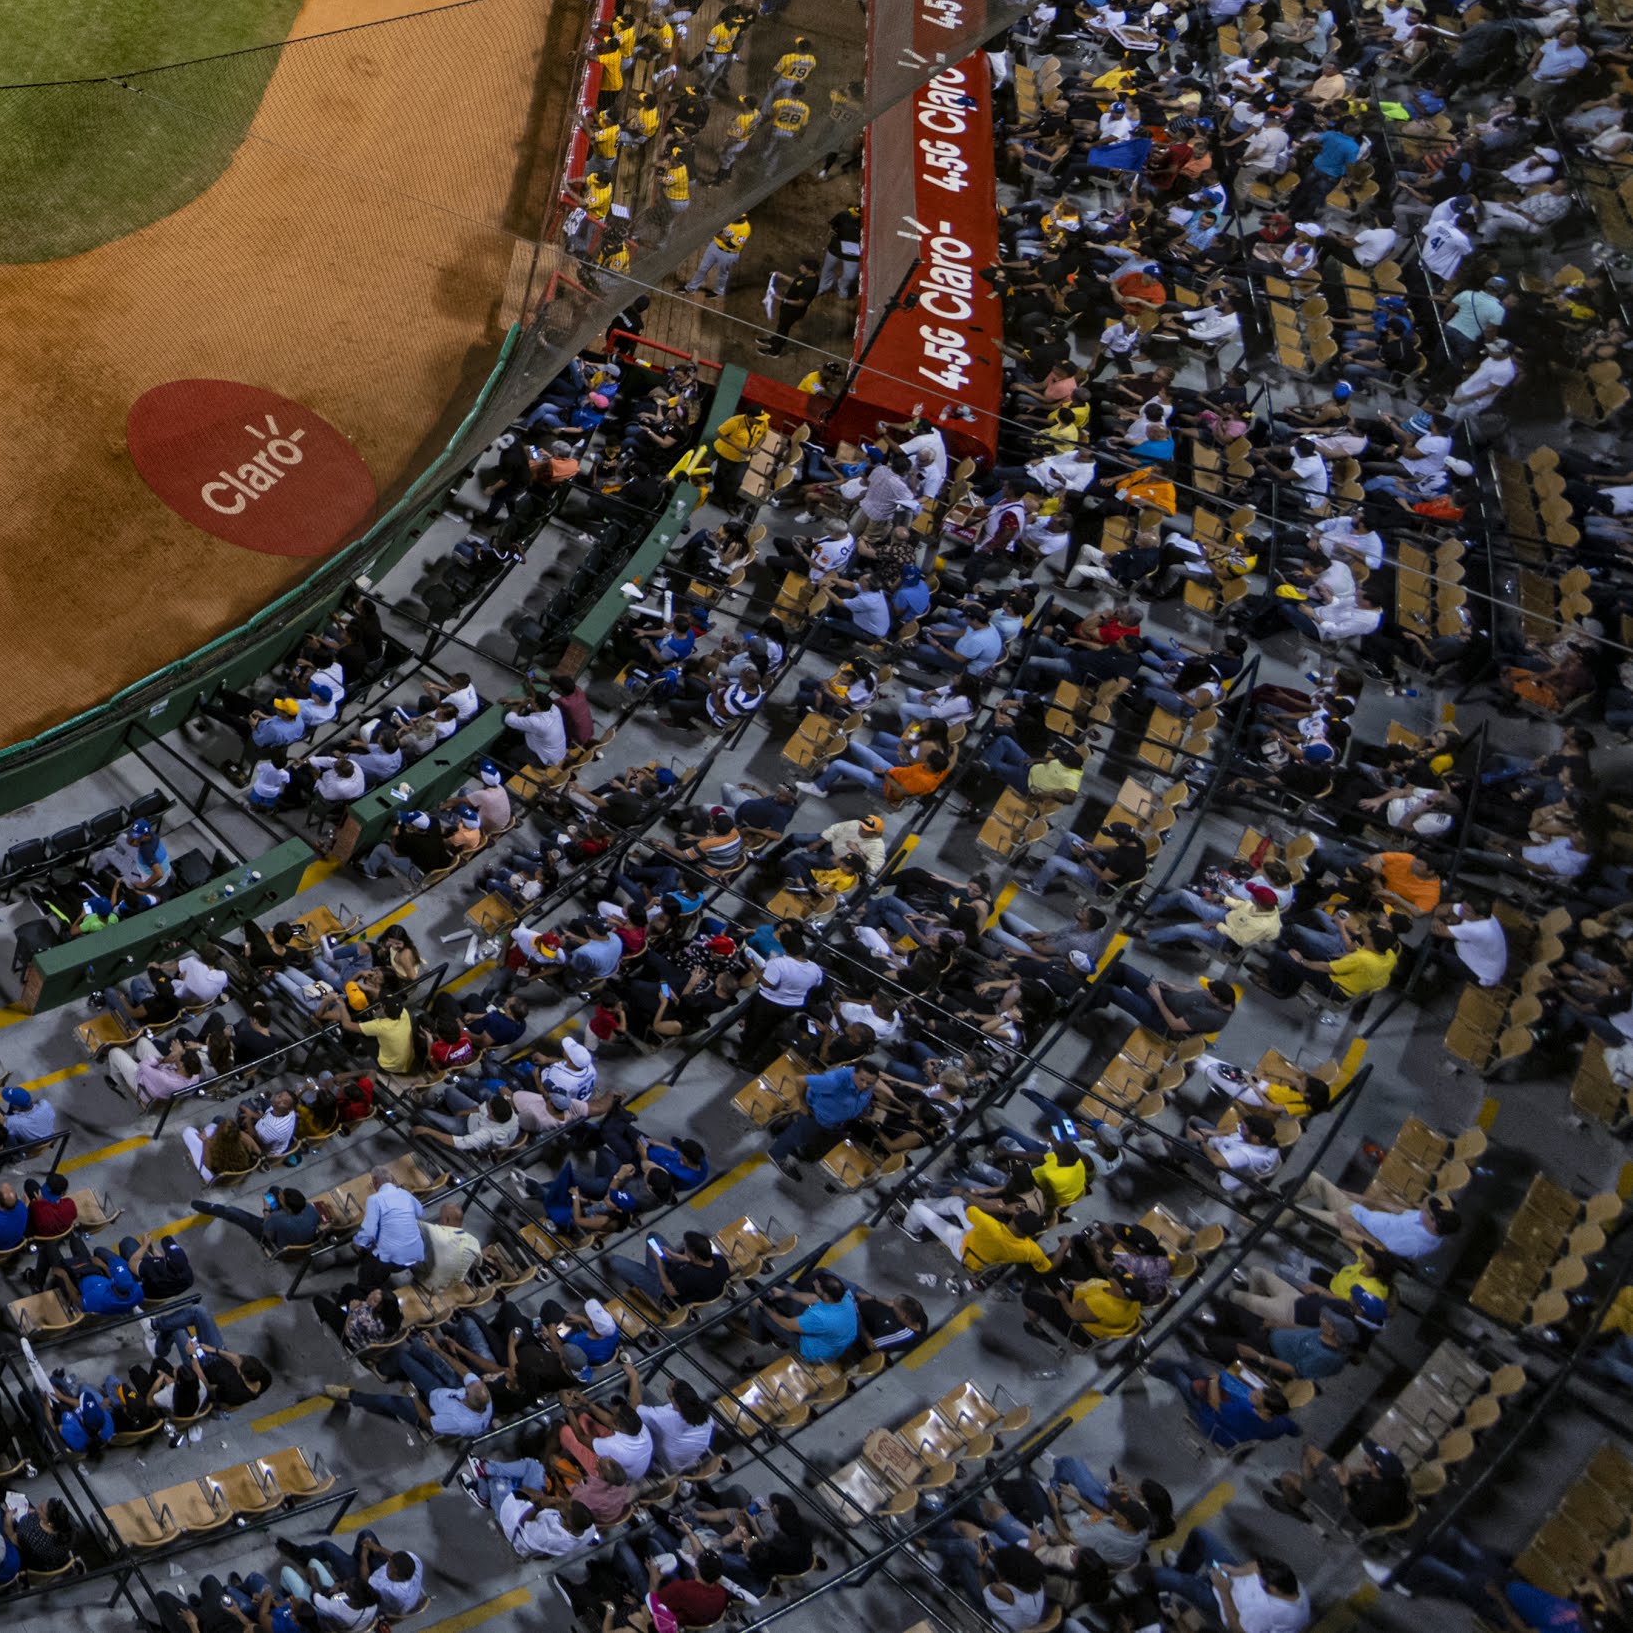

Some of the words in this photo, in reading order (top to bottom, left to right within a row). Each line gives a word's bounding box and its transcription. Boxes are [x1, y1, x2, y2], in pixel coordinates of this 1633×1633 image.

[919, 138, 969, 194] 4.5G
[919, 235, 974, 321] Claro
[918, 324, 973, 392] 4.5G
[200, 438, 304, 516] Claro
